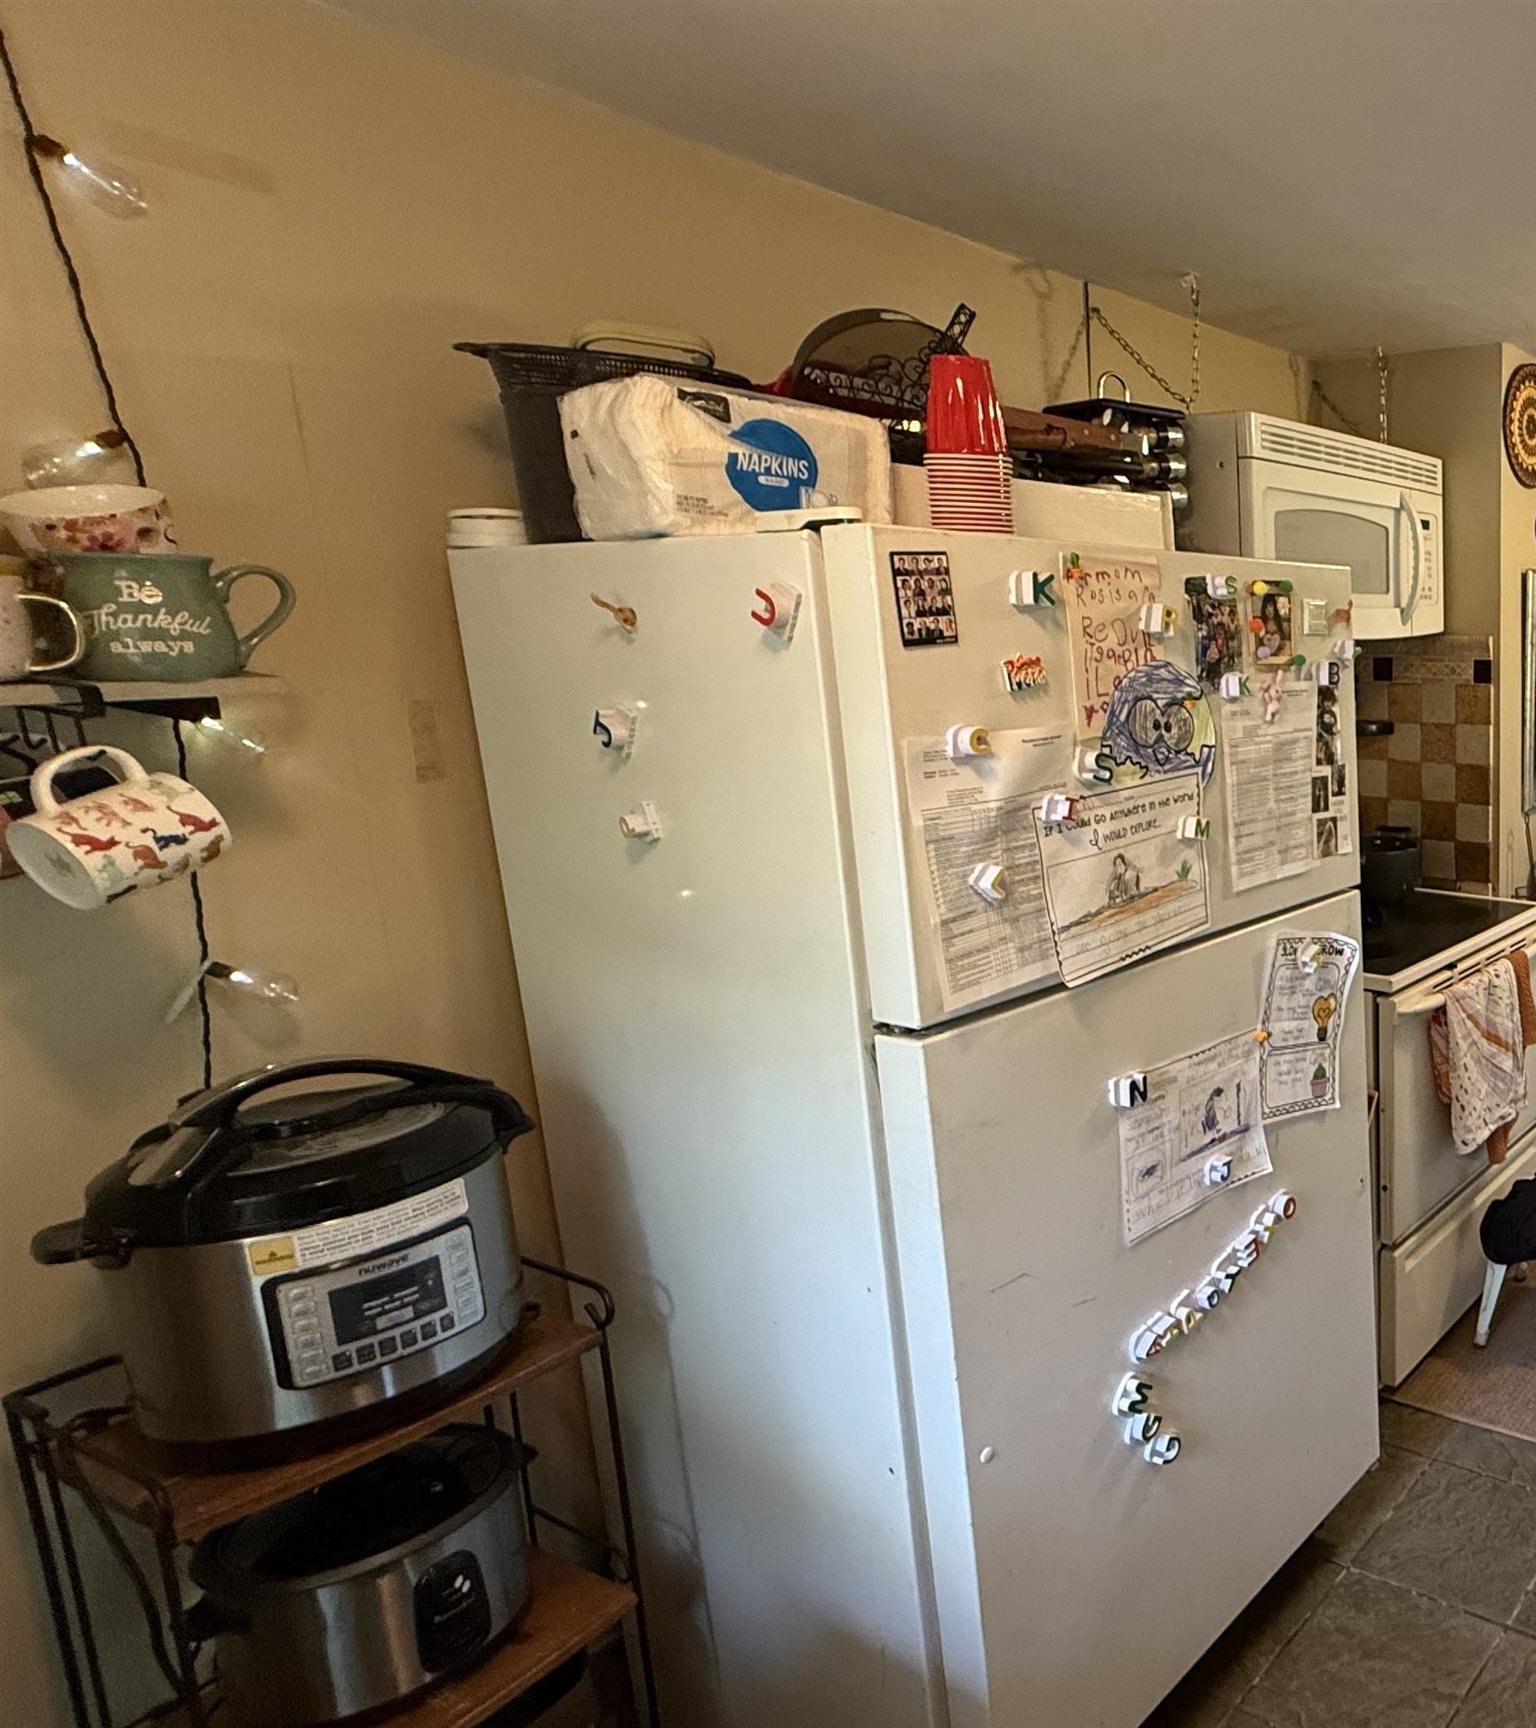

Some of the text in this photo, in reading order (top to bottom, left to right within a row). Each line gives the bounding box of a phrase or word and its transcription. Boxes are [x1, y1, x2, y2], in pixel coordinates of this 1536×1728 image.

[736, 451, 809, 480] NAPKINS
[113, 579, 164, 605] Be
[1032, 571, 1055, 606] K
[80, 602, 212, 638] Thankful
[109, 637, 195, 657] always
